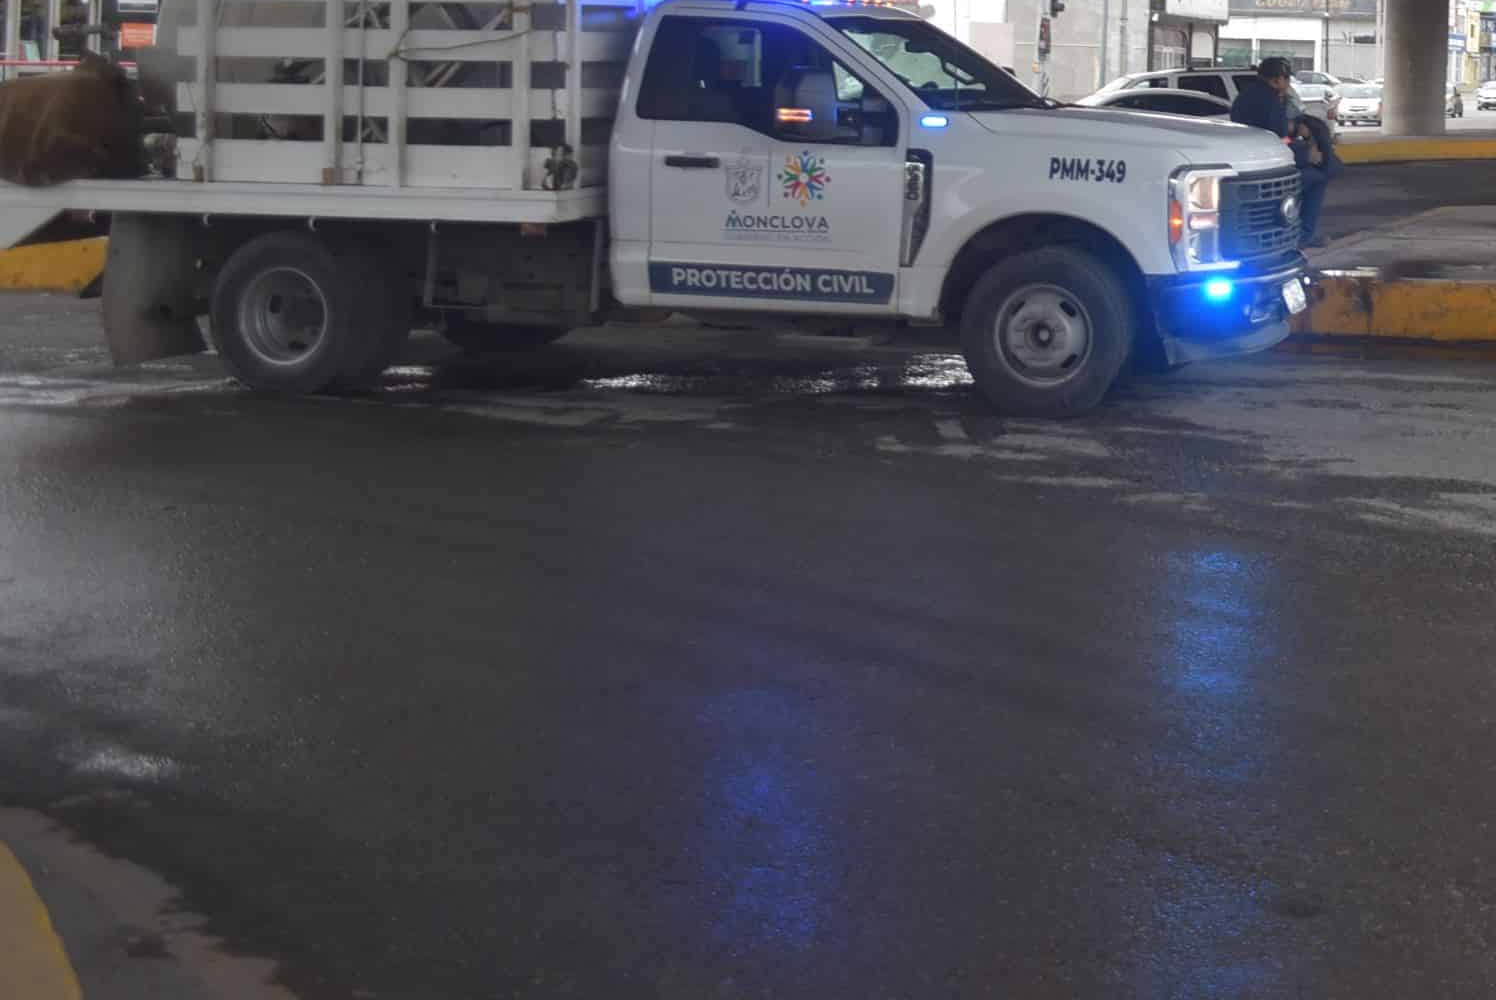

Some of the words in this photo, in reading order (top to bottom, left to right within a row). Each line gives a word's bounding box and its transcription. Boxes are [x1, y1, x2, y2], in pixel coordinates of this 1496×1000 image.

[1049, 157, 1127, 184] PMM-349
[725, 212, 830, 231] MONCLOVA
[671, 267, 812, 292] PROTECCIÓN
[817, 274, 876, 294] CIVIL
